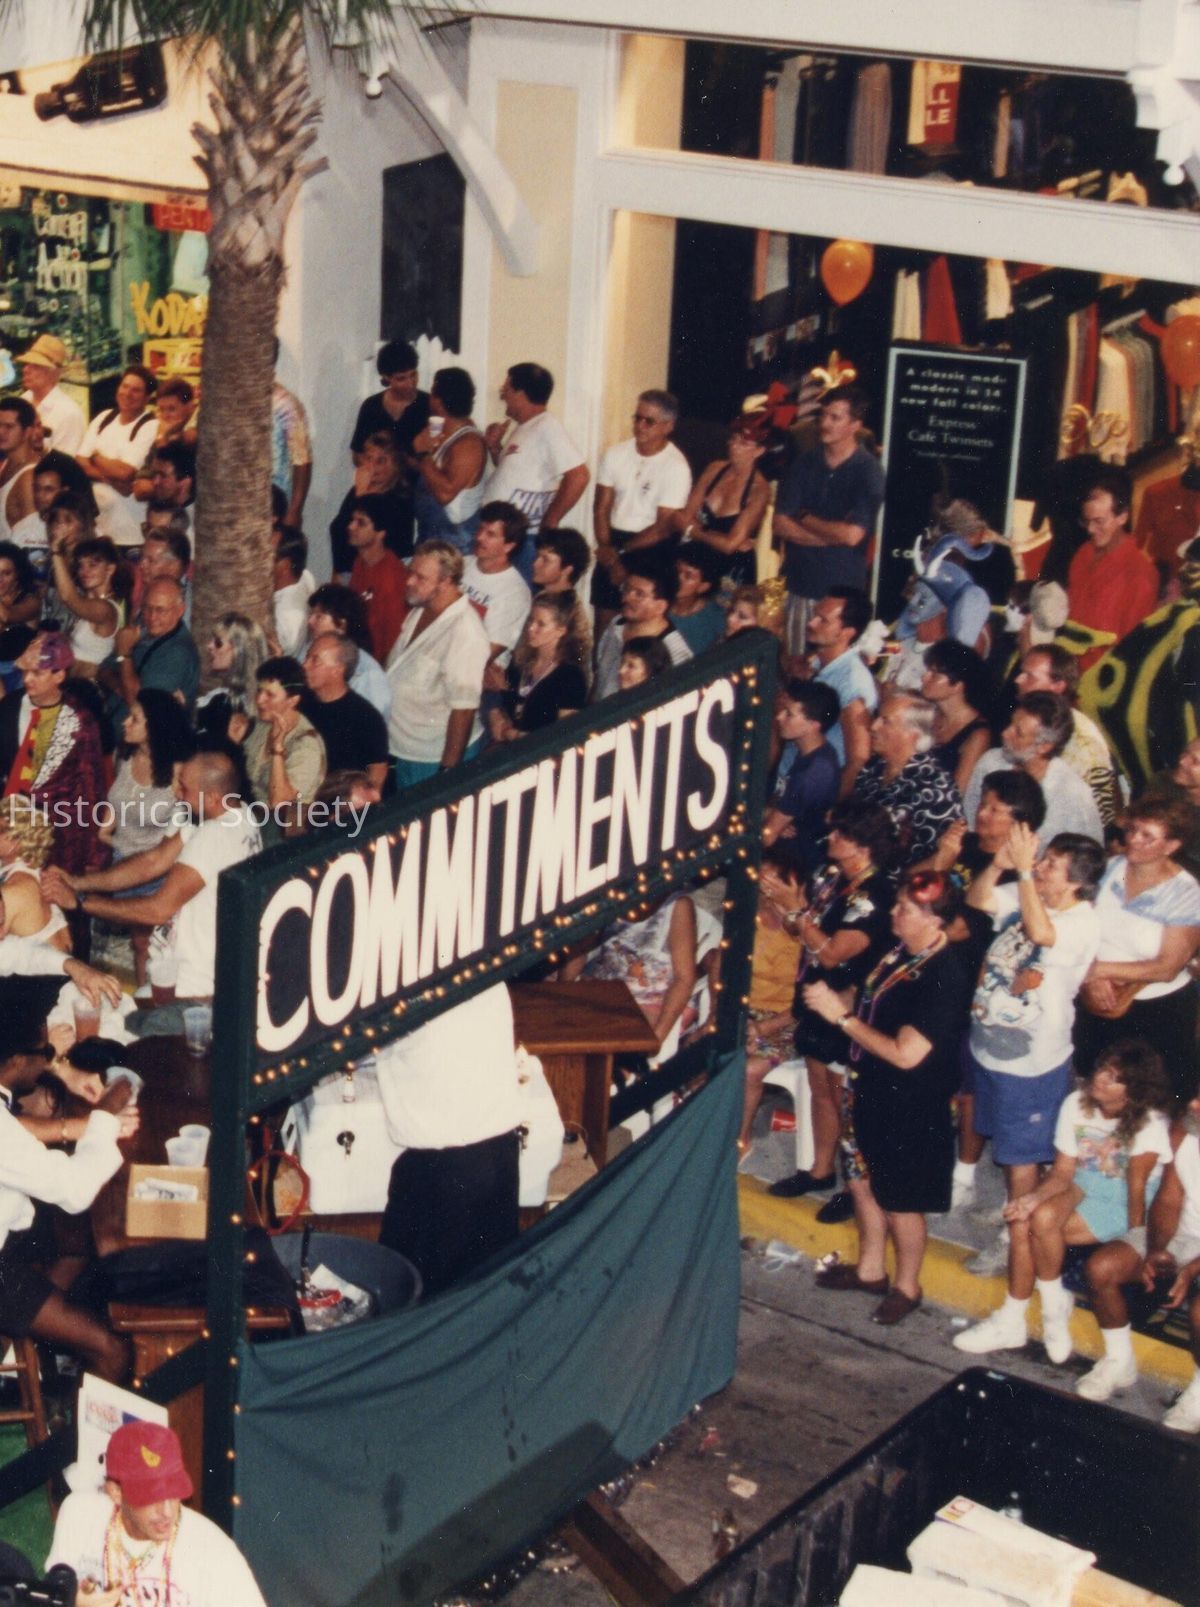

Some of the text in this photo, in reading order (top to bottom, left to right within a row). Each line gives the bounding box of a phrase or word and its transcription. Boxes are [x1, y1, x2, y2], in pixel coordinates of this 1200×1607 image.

[128, 280, 210, 337] KODA
[928, 414, 976, 430] Express
[257, 678, 735, 1053] COMMITMENTS
